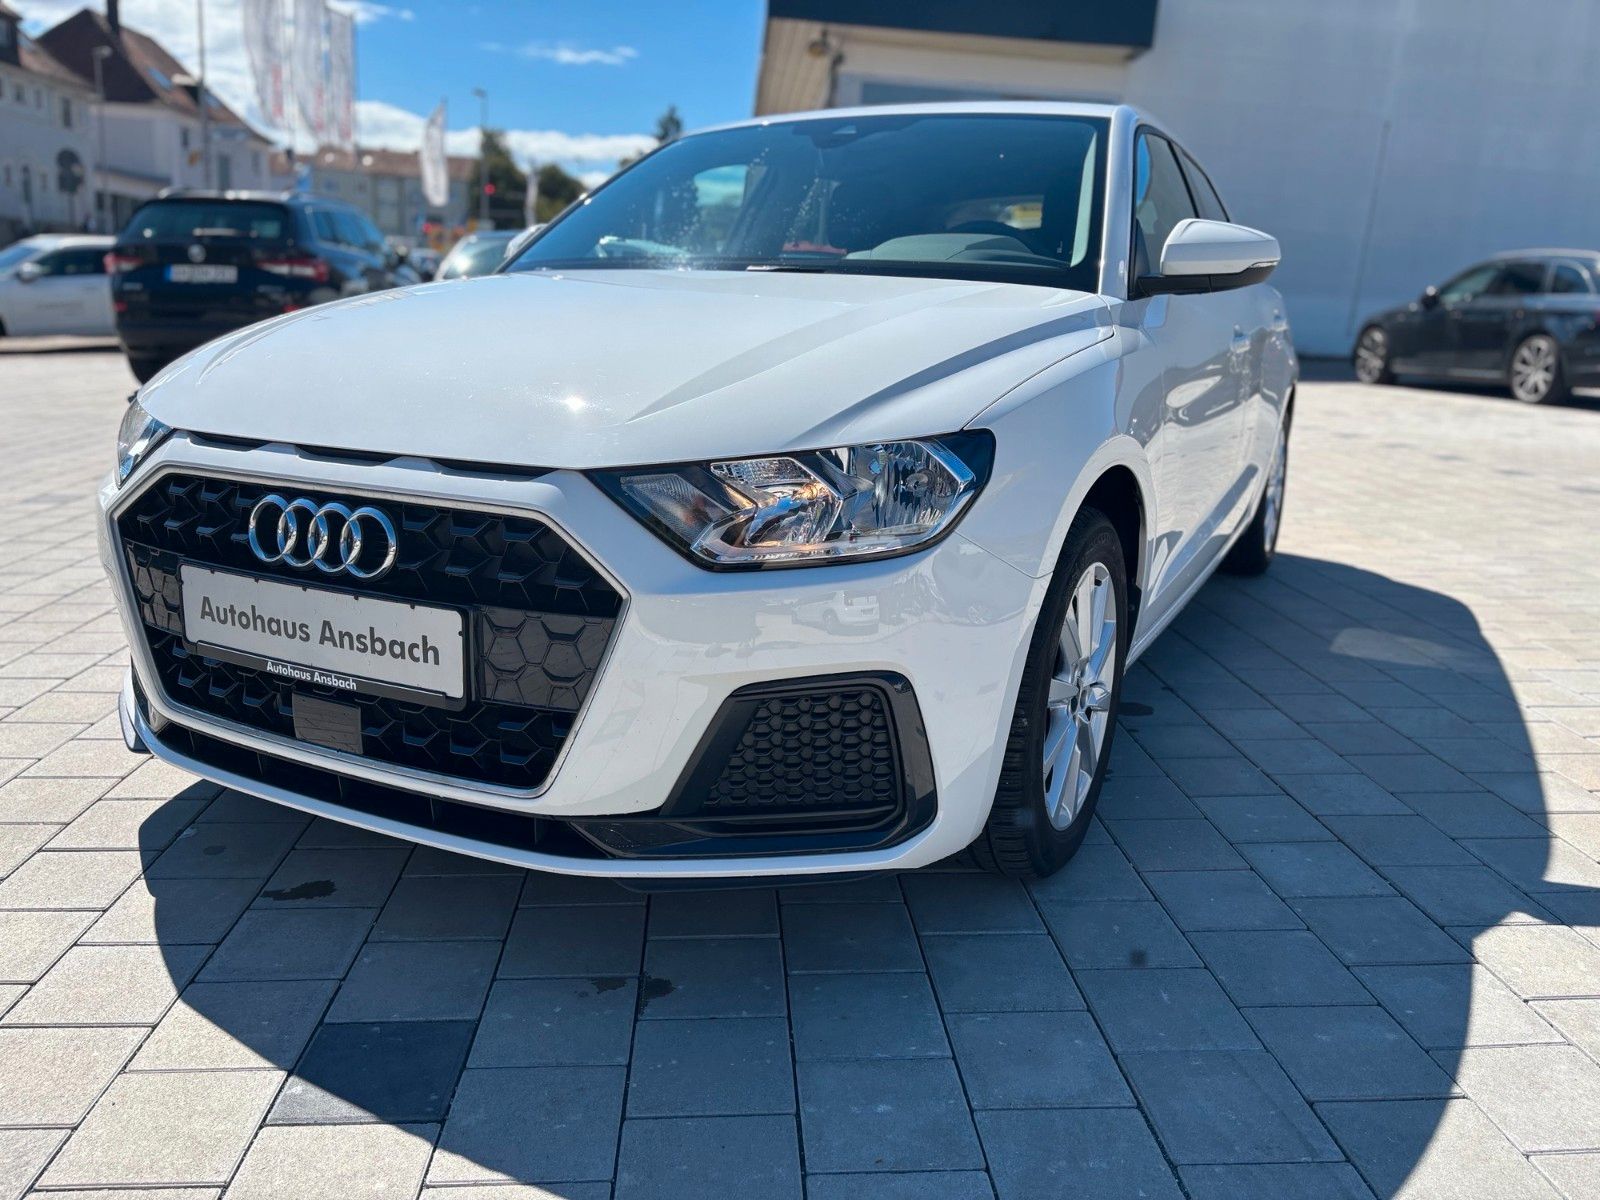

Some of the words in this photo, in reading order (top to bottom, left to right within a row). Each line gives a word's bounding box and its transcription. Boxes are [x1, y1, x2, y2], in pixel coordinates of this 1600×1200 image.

[200, 596, 311, 642] Autohaus
[318, 620, 440, 666] Ansbach
[266, 661, 311, 681] Autohaus
[313, 671, 357, 691] Ansbach
